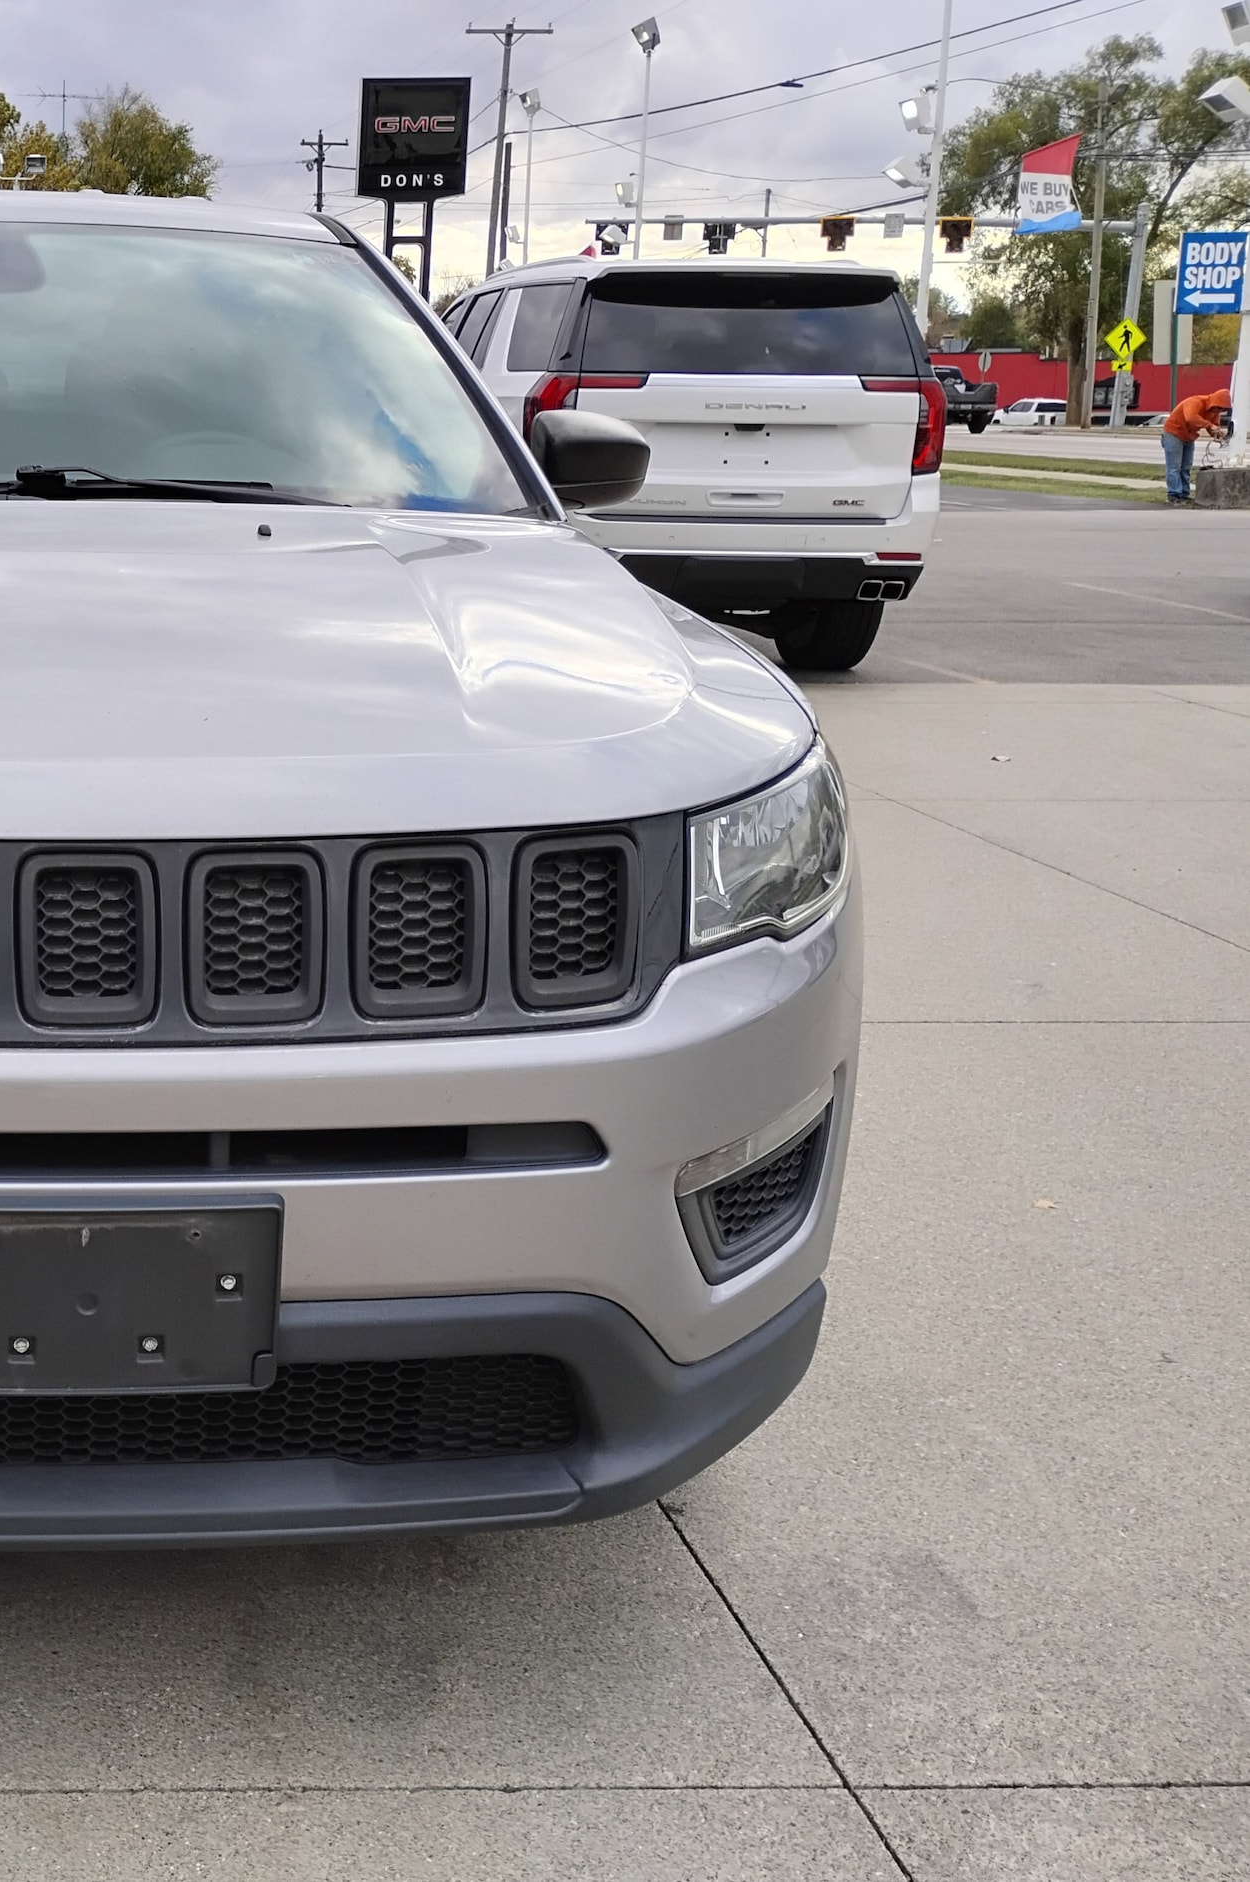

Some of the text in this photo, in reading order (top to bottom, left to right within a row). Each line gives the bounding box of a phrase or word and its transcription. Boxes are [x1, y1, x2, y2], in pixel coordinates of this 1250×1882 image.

[374, 116, 456, 133] GMC
[380, 174, 444, 187] DON'S
[1021, 181, 1069, 197] WE BUY
[1029, 200, 1068, 214] CARS
[1186, 242, 1244, 265] BODY
[1183, 266, 1241, 289] SHOP
[705, 403, 806, 411] DENALI
[832, 499, 865, 507] GMC
